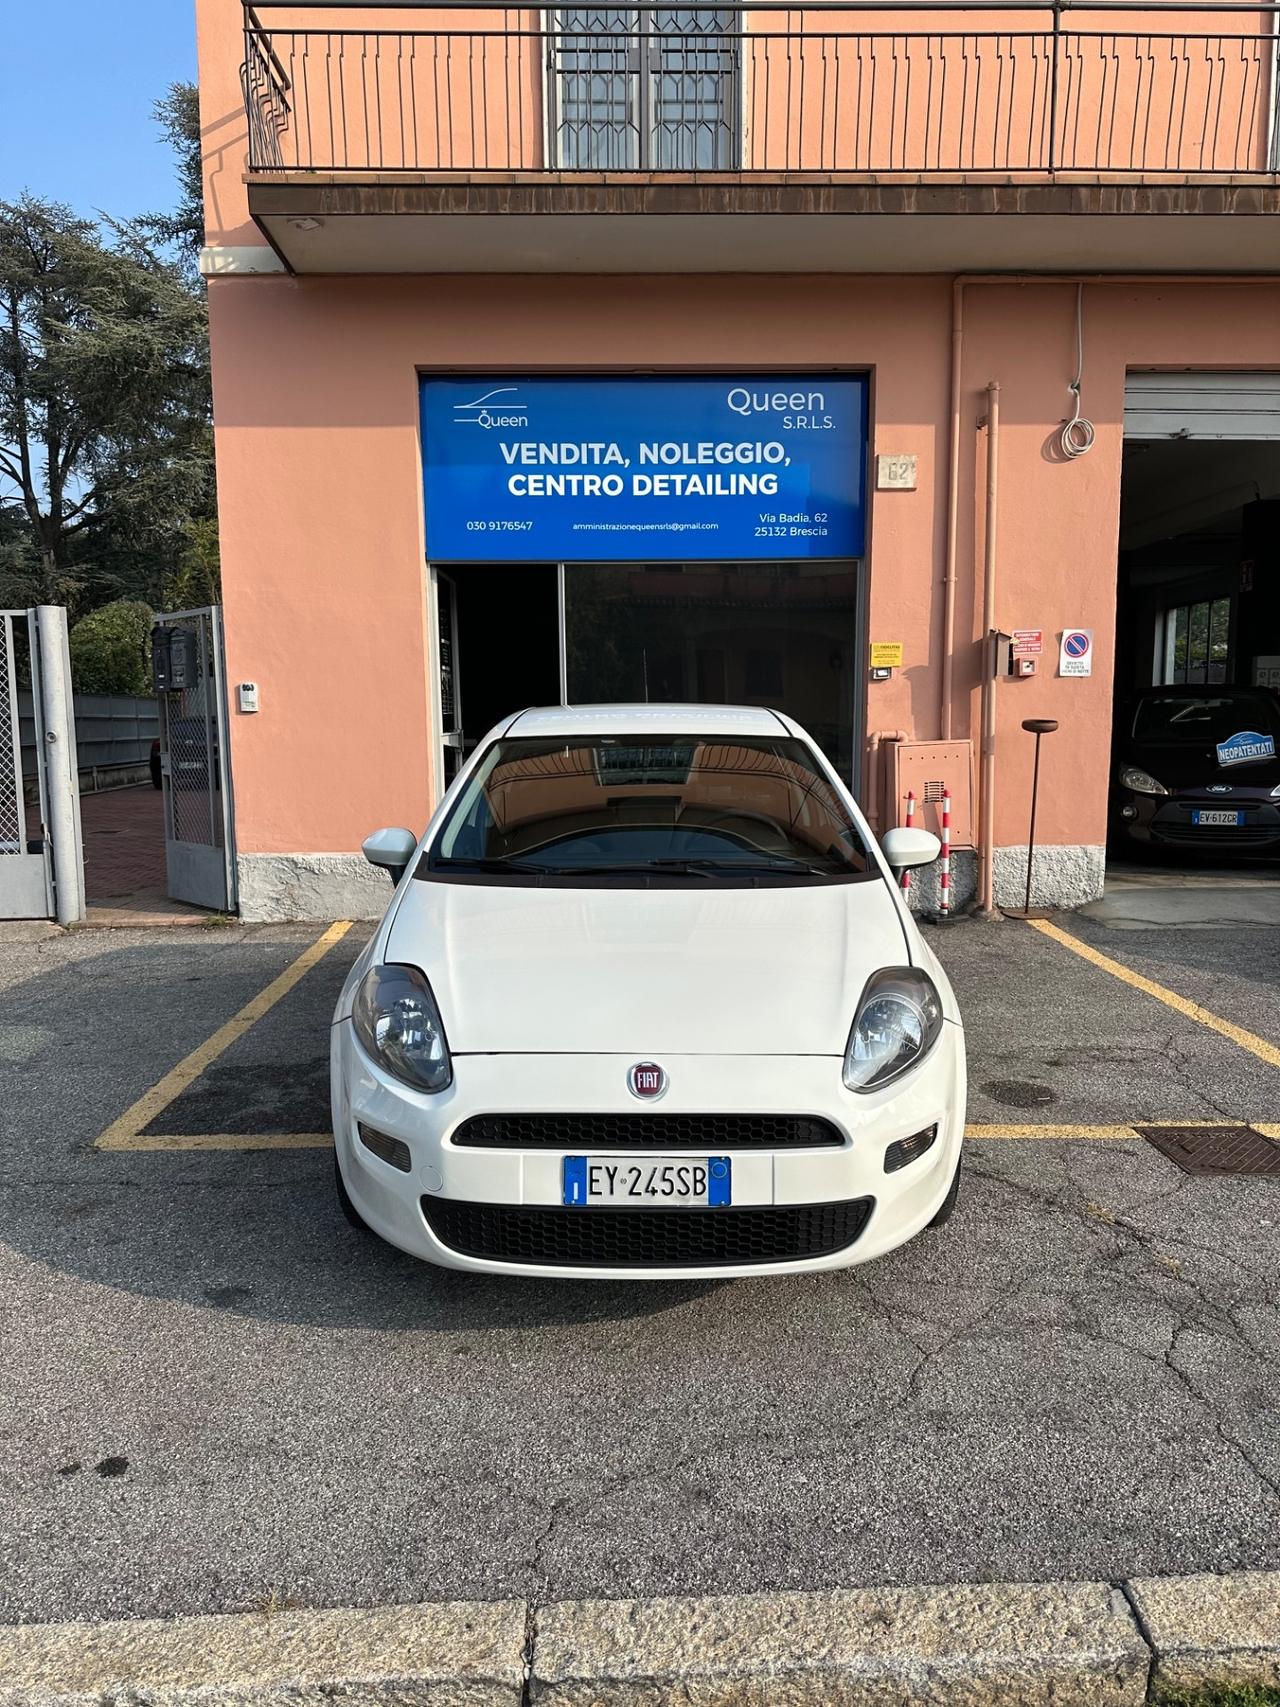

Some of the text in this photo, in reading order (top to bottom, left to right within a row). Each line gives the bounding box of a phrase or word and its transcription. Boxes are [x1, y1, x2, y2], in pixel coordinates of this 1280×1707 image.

[727, 387, 825, 416] Queen
[478, 412, 528, 429] Queen
[783, 415, 836, 429] S.R.L.S.
[499, 441, 791, 468] VENDITA, NOLEGGIO,
[508, 473, 778, 496] CENTRO DETAILING
[466, 521, 533, 531] 030 9176547
[759, 513, 776, 523] Via
[814, 513, 828, 523] 62
[572, 522, 719, 532] amministrazionequeensrls@gmail.com
[754, 526, 828, 537] 25132 Brescia
[1219, 741, 1273, 761] NEOPATENTATI
[637, 1072, 659, 1088] FIAT
